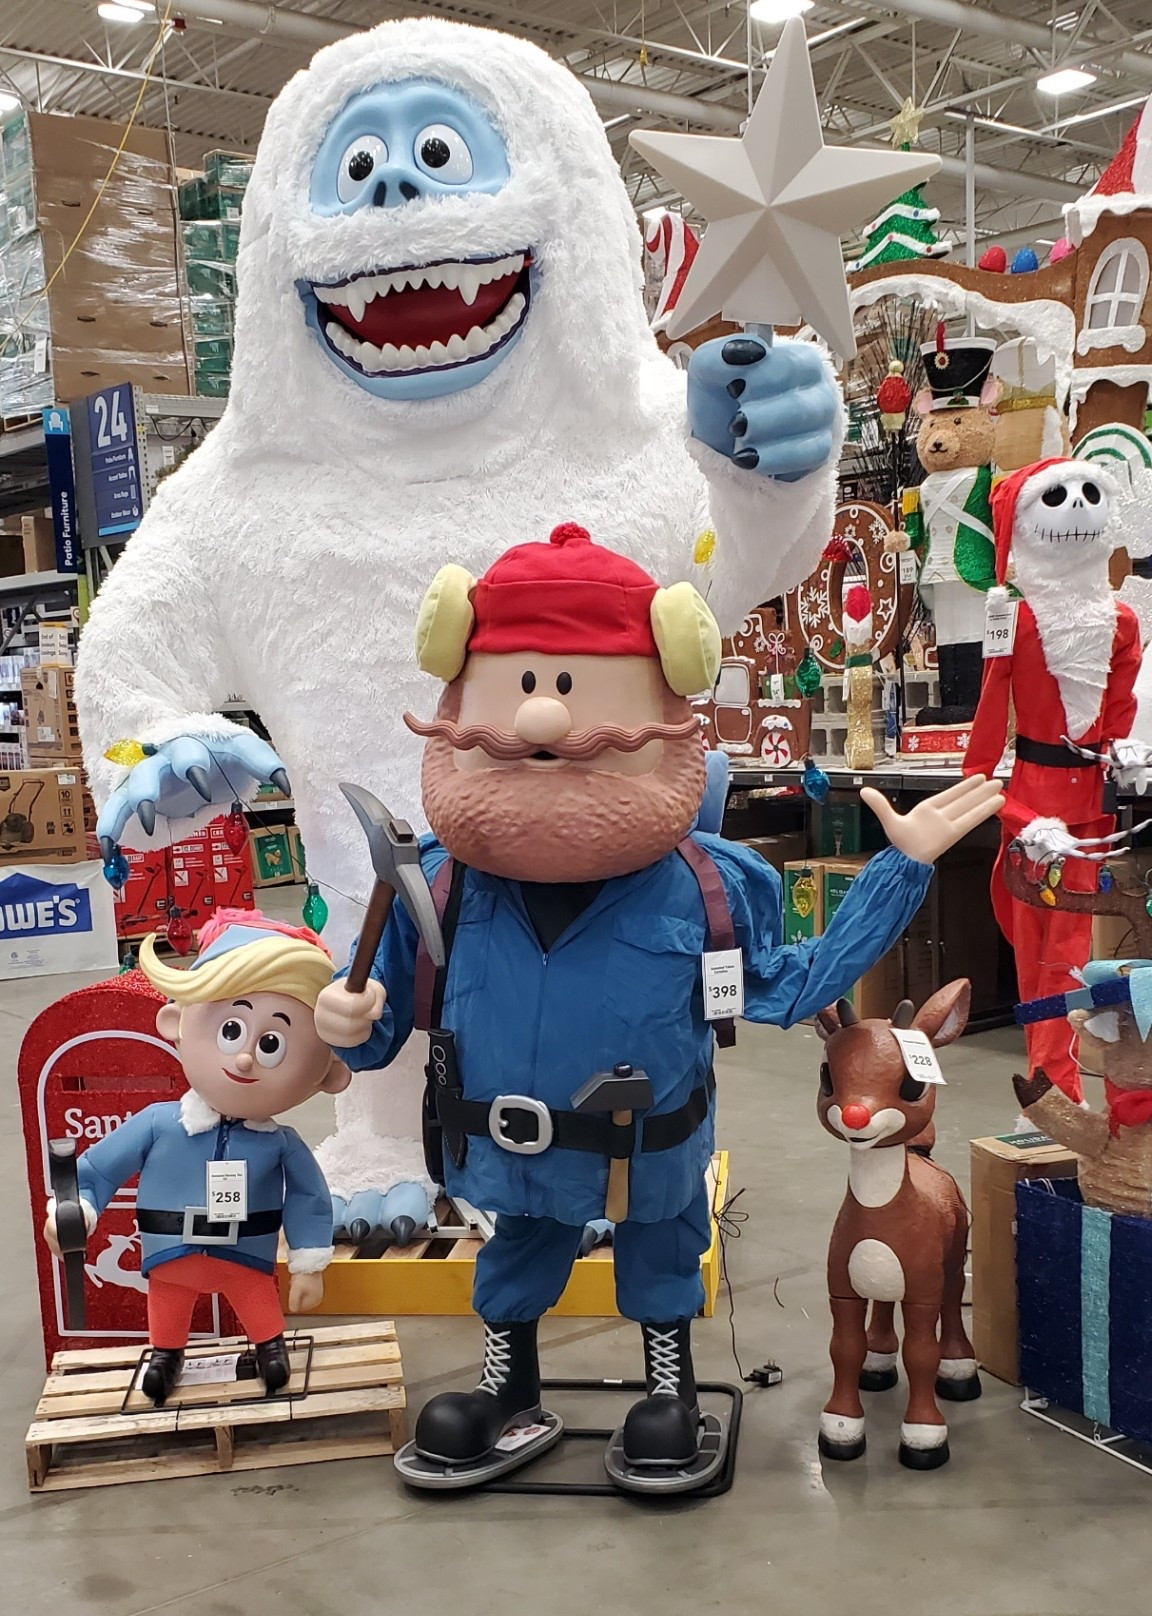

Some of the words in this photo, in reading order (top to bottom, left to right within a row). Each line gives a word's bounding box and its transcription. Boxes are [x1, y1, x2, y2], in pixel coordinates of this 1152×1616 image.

[95, 391, 127, 447] 24
[61, 491, 71, 538] Furniture
[64, 539, 73, 566] Patio
[986, 629, 1009, 640] $198
[0, 895, 77, 931] WE'S
[708, 984, 737, 999] $398
[909, 1054, 932, 1067] $228
[211, 1191, 241, 1203] $258
